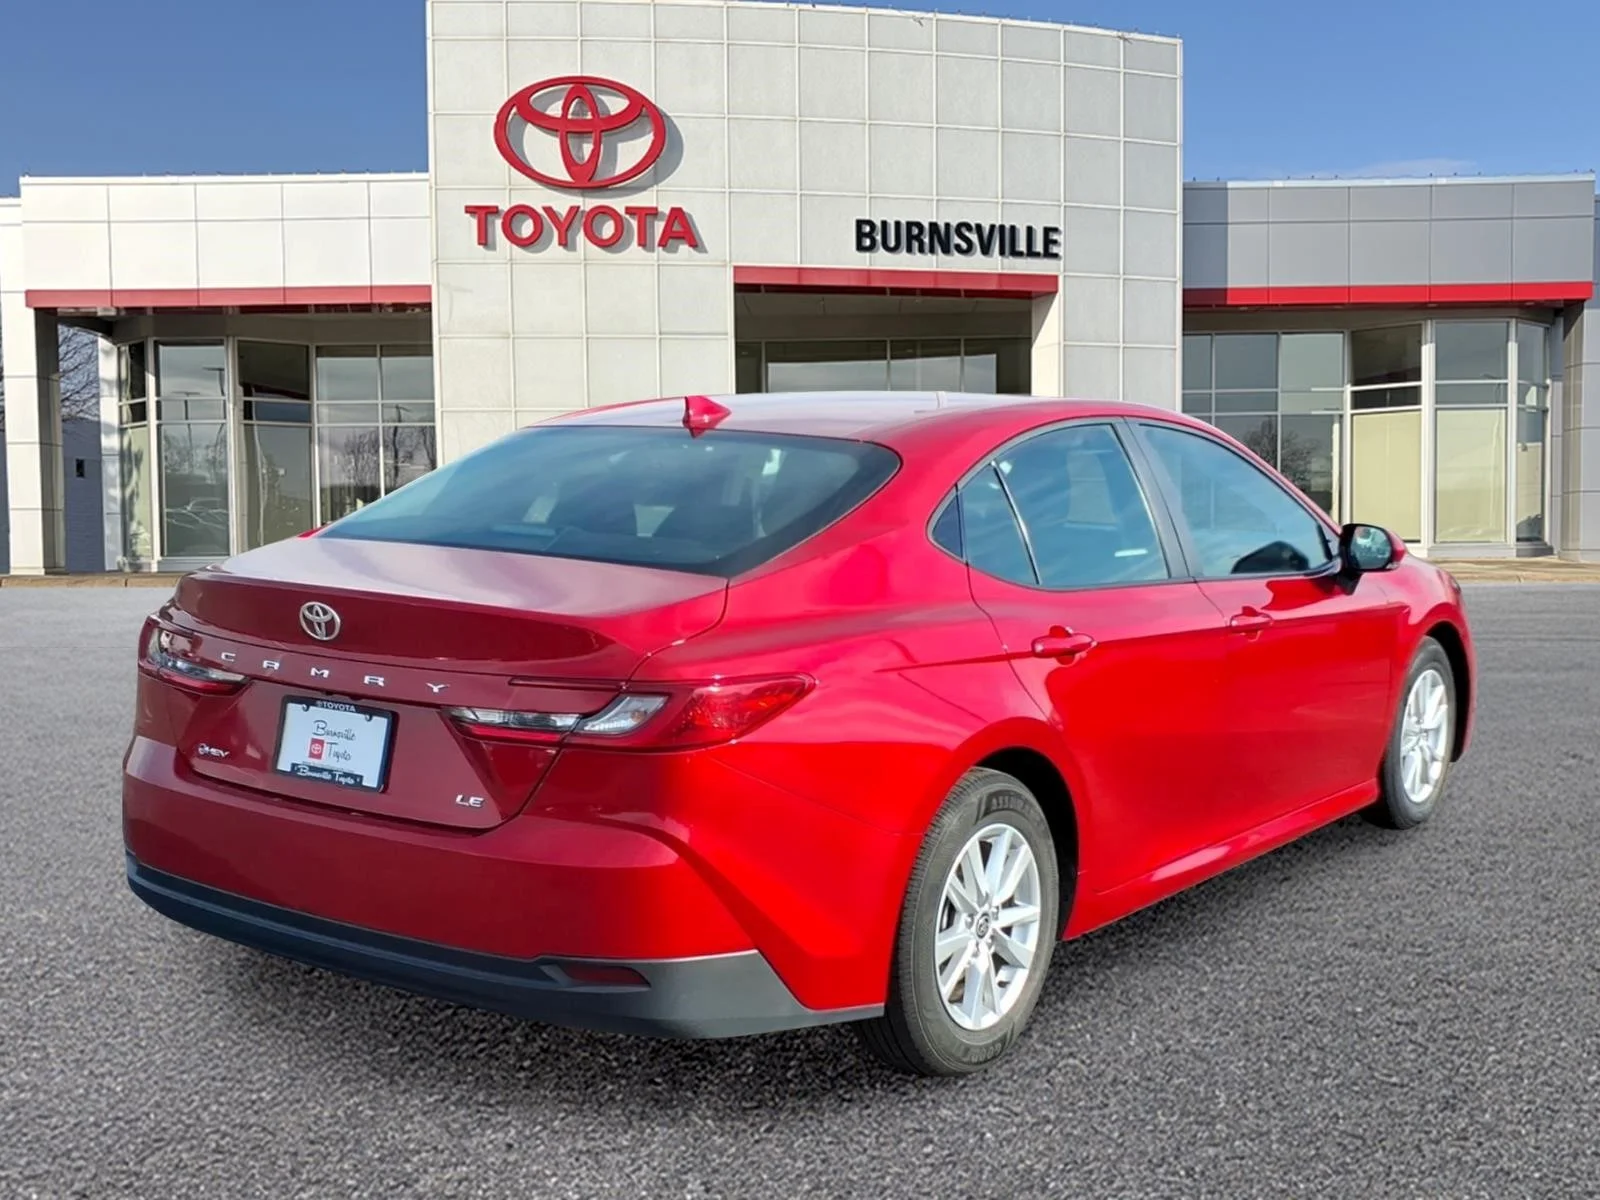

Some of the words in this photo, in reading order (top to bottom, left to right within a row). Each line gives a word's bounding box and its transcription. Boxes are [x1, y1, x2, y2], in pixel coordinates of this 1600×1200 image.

[465, 204, 699, 248] TOYOTA
[855, 219, 1060, 259] BURNSVILLE
[221, 652, 450, 693] CAMRY
[322, 701, 356, 713] TOYOTA
[455, 794, 484, 808] LE
